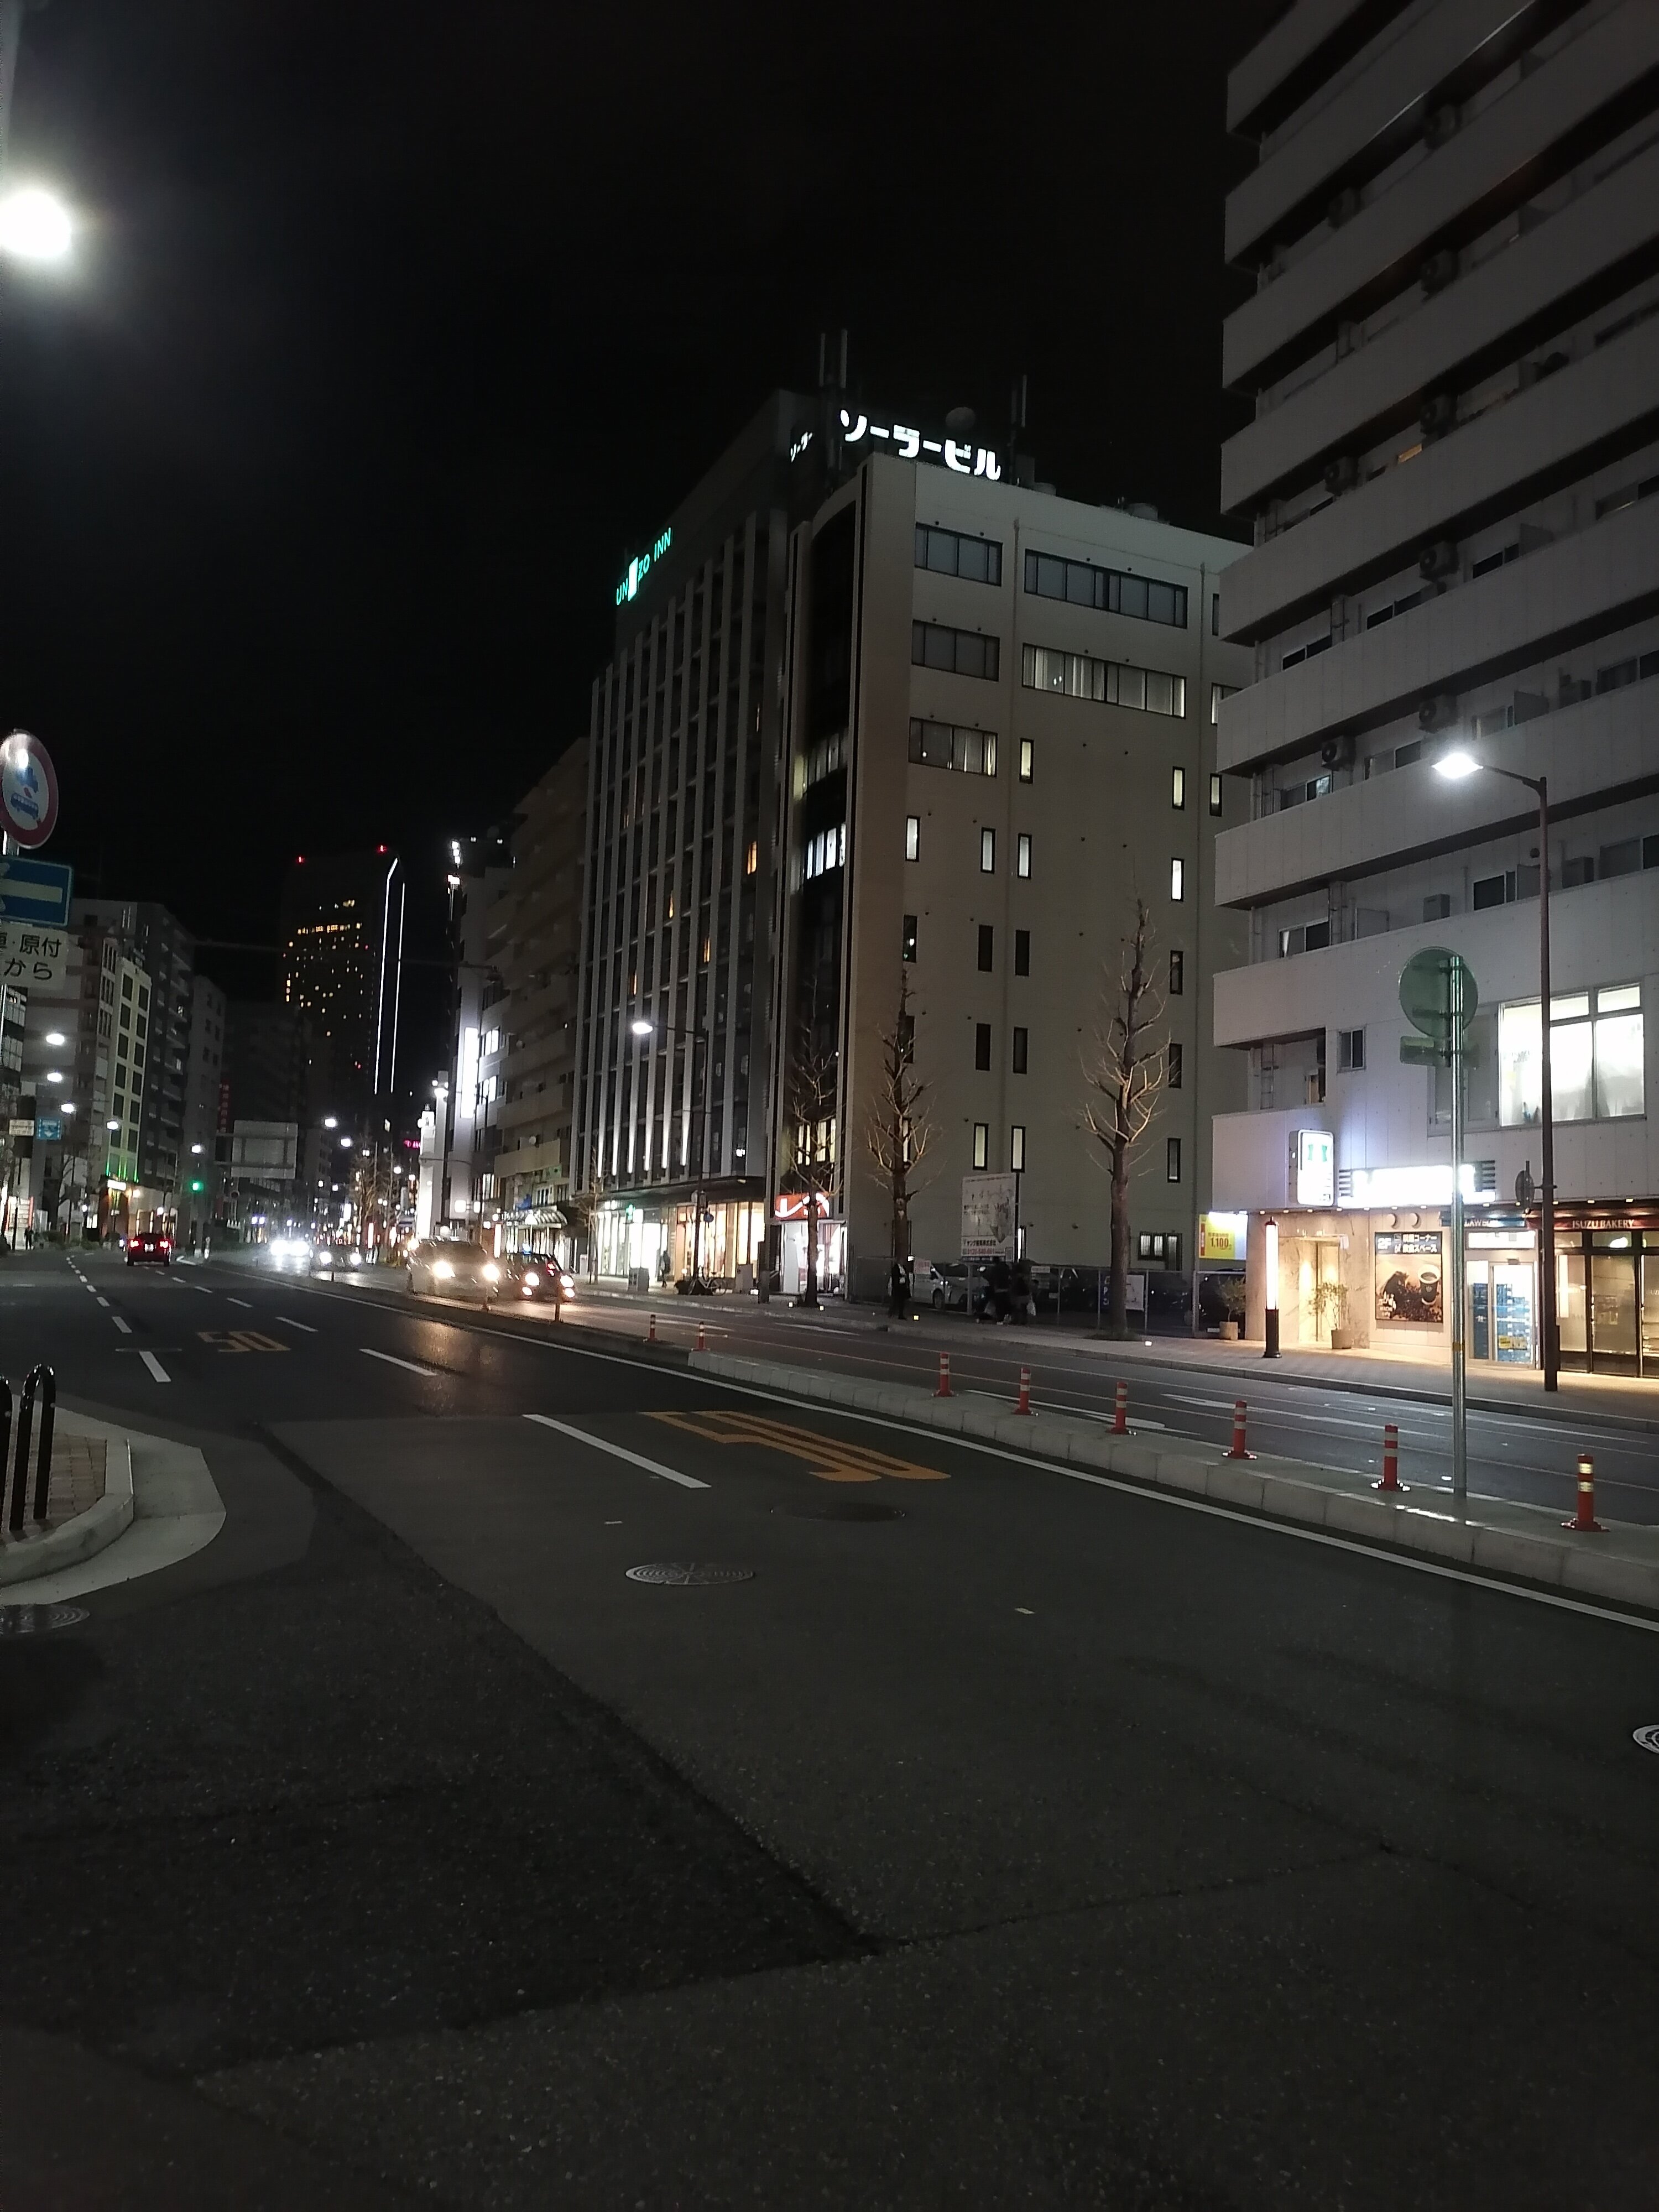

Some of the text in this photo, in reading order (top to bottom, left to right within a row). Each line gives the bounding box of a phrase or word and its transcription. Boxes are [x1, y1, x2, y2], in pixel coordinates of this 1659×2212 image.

[840, 409, 1001, 481] ソーラービル
[654, 527, 671, 563] INN
[3, 957, 53, 980] から
[1572, 1219, 1635, 1229] ISUZU BAKERY
[1378, 1237, 1392, 1250] 2F
[195, 1330, 291, 1353] 50
[636, 1410, 952, 1483] 50
